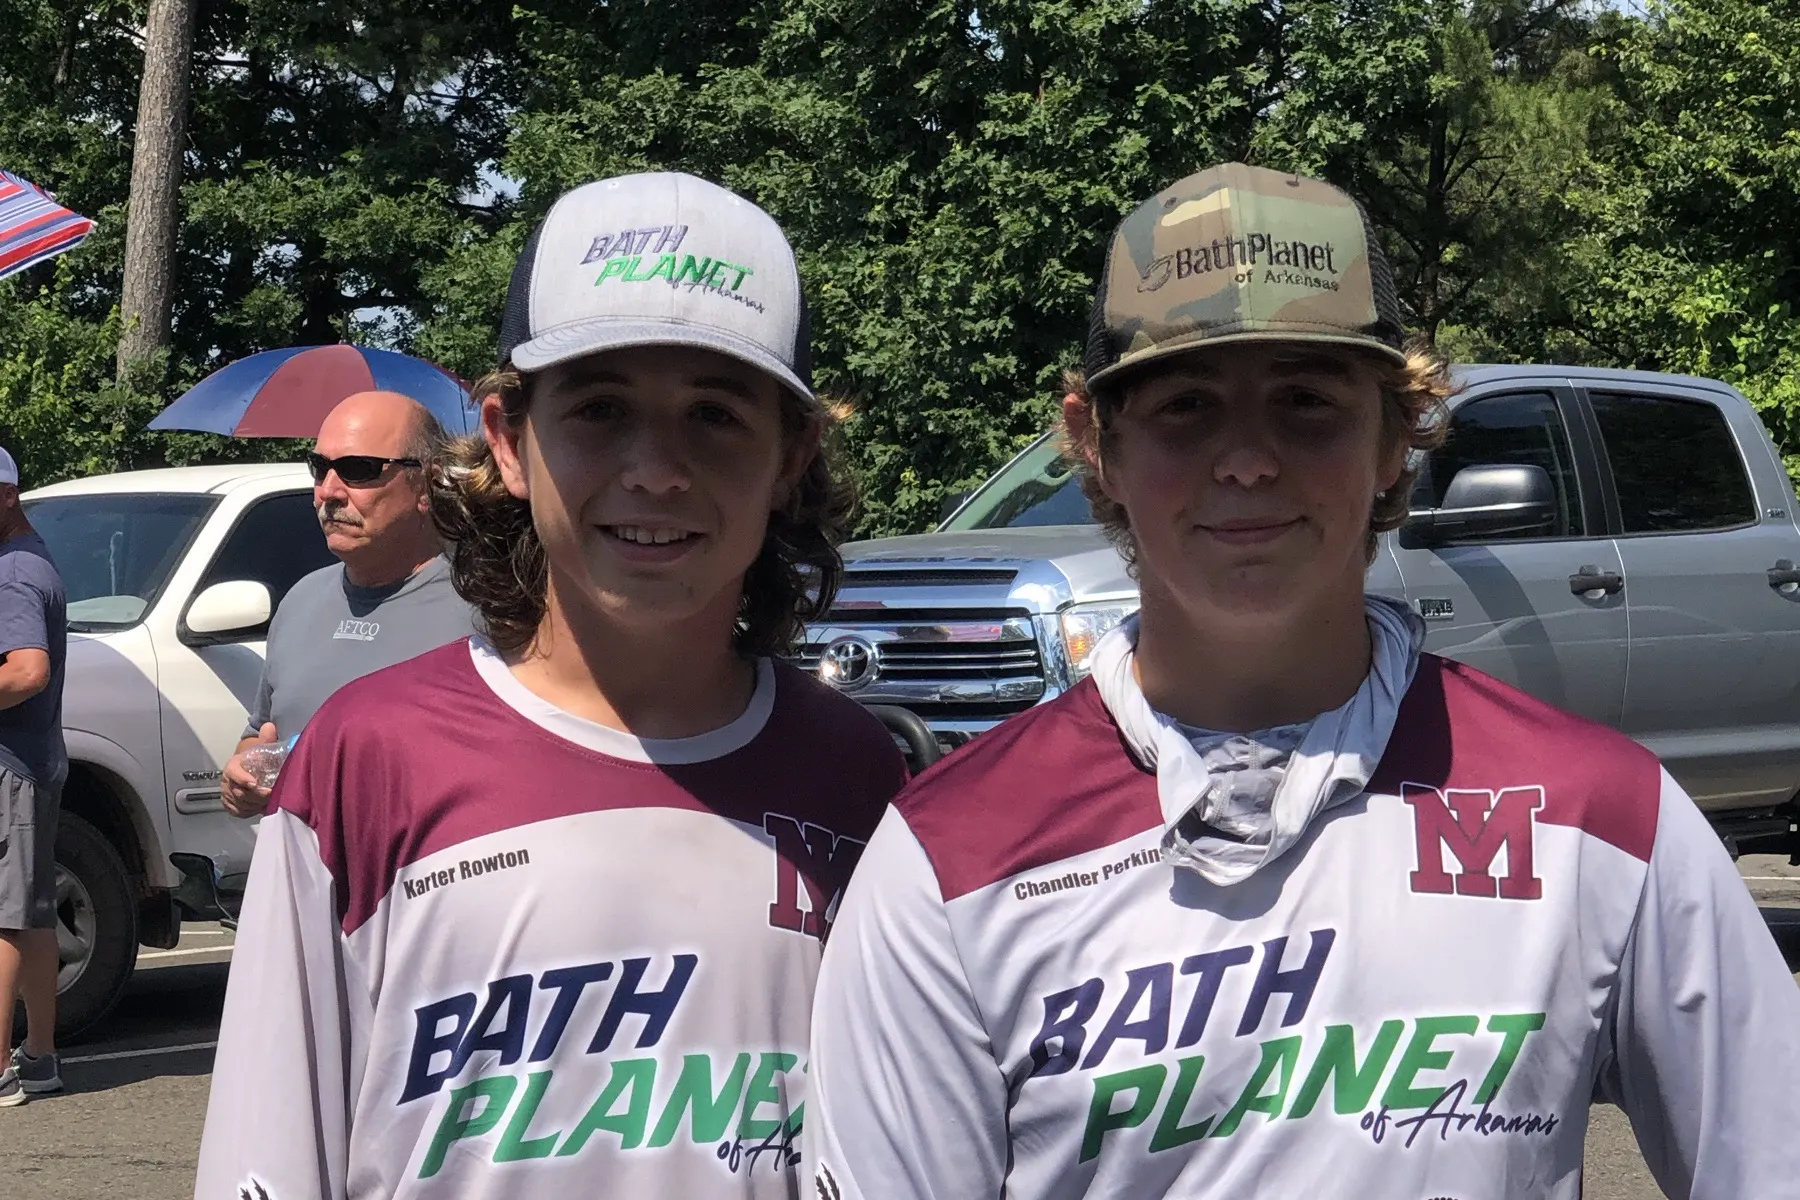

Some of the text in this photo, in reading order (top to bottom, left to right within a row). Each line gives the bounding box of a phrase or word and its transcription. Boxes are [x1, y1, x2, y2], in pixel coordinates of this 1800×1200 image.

[580, 225, 688, 264] BATH
[595, 253, 753, 291] PLANET
[1234, 269, 1252, 283] of
[334, 619, 380, 637] AFTCO
[403, 848, 530, 899] Karter Rowton
[1014, 871, 1099, 900] Chandler
[1030, 928, 1336, 1078] BATH
[396, 953, 698, 1106] BATH
[1078, 1012, 1546, 1164] PLANET
[417, 1052, 808, 1179] PLANE
[1361, 1079, 1560, 1148] of Arkansas
[717, 1134, 743, 1173] of
